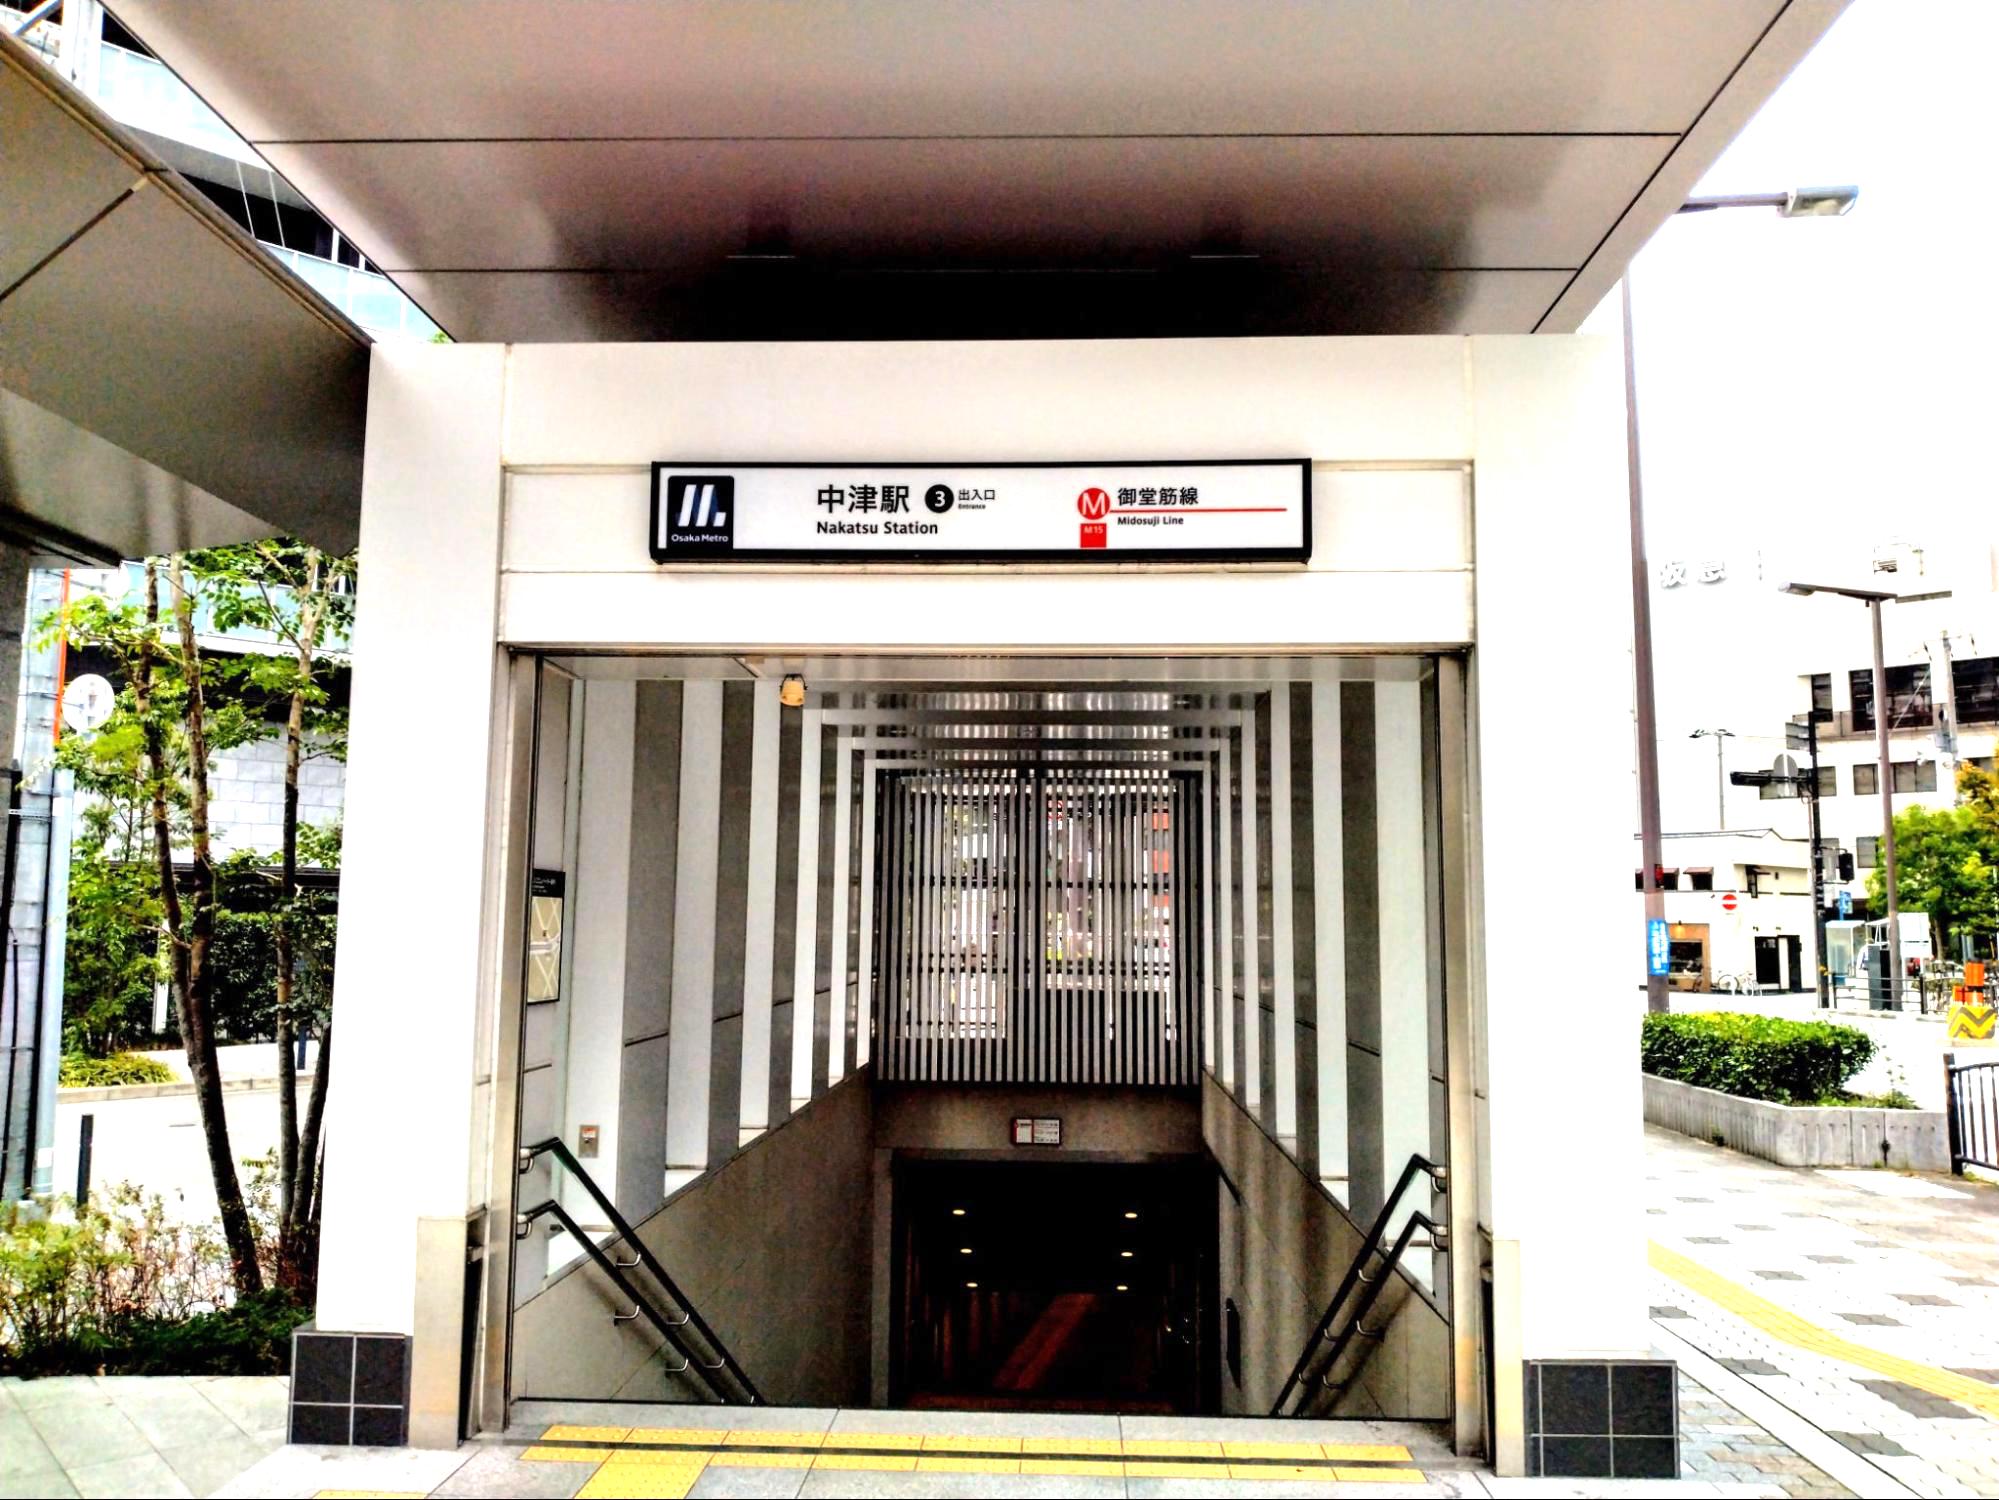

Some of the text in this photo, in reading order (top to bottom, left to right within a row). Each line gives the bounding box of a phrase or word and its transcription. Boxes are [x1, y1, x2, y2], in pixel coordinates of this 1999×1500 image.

[817, 484, 909, 513] 中津駅
[958, 489, 995, 501] 出入口
[1117, 487, 1198, 505] 御堂筋線
[1082, 492, 1106, 514] M
[817, 521, 938, 534] Nakatsu Station
[1117, 516, 1184, 527] Midosuji Line
[671, 534, 728, 542] Osaka Metro
